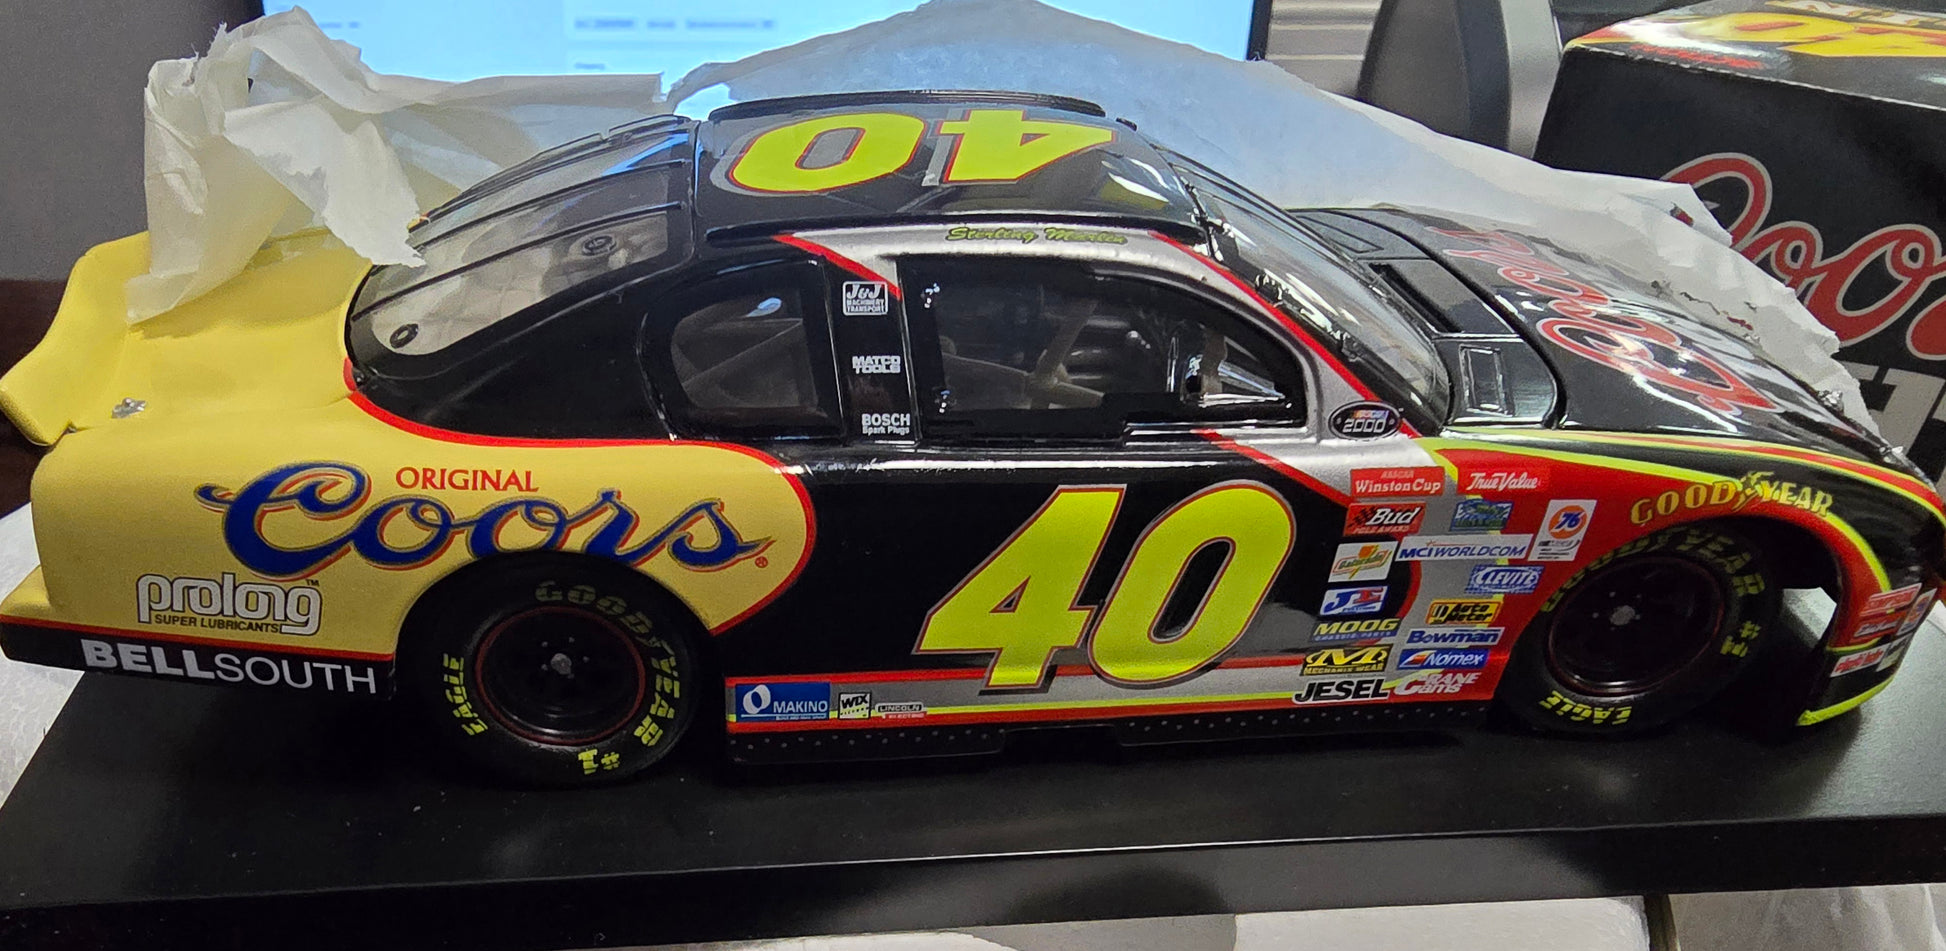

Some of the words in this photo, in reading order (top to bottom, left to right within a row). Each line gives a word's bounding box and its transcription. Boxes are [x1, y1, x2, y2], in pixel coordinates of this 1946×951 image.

[728, 109, 1115, 193] 40
[945, 226, 1039, 244] Sterling
[846, 284, 882, 299] J&J
[852, 356, 901, 367] MATCO
[854, 365, 901, 374] TOOLS
[861, 413, 911, 426] BOSCH
[1342, 418, 1387, 433] 2000
[862, 426, 886, 436] Spark
[887, 426, 910, 435] Plugs
[395, 466, 539, 492] ORIGINAL
[1355, 479, 1411, 494] Winston
[1412, 478, 1441, 494] Cup
[193, 460, 776, 582] Coors
[1366, 506, 1421, 526] Bud
[1556, 511, 1585, 530] 76
[911, 479, 1297, 690] 40
[1475, 569, 1538, 585] CLEVITE
[136, 572, 323, 636] prolong
[155, 614, 197, 628] SUPER
[200, 617, 280, 634] LUBRICANTS
[1313, 619, 1400, 636] MOOG
[1406, 631, 1499, 646] Bowman
[1425, 652, 1483, 666] Nomex
[1294, 678, 1388, 702] JESEL
[773, 700, 829, 714] MAKINO
[841, 694, 869, 710] WIX
[880, 704, 920, 712] LINCOLN
